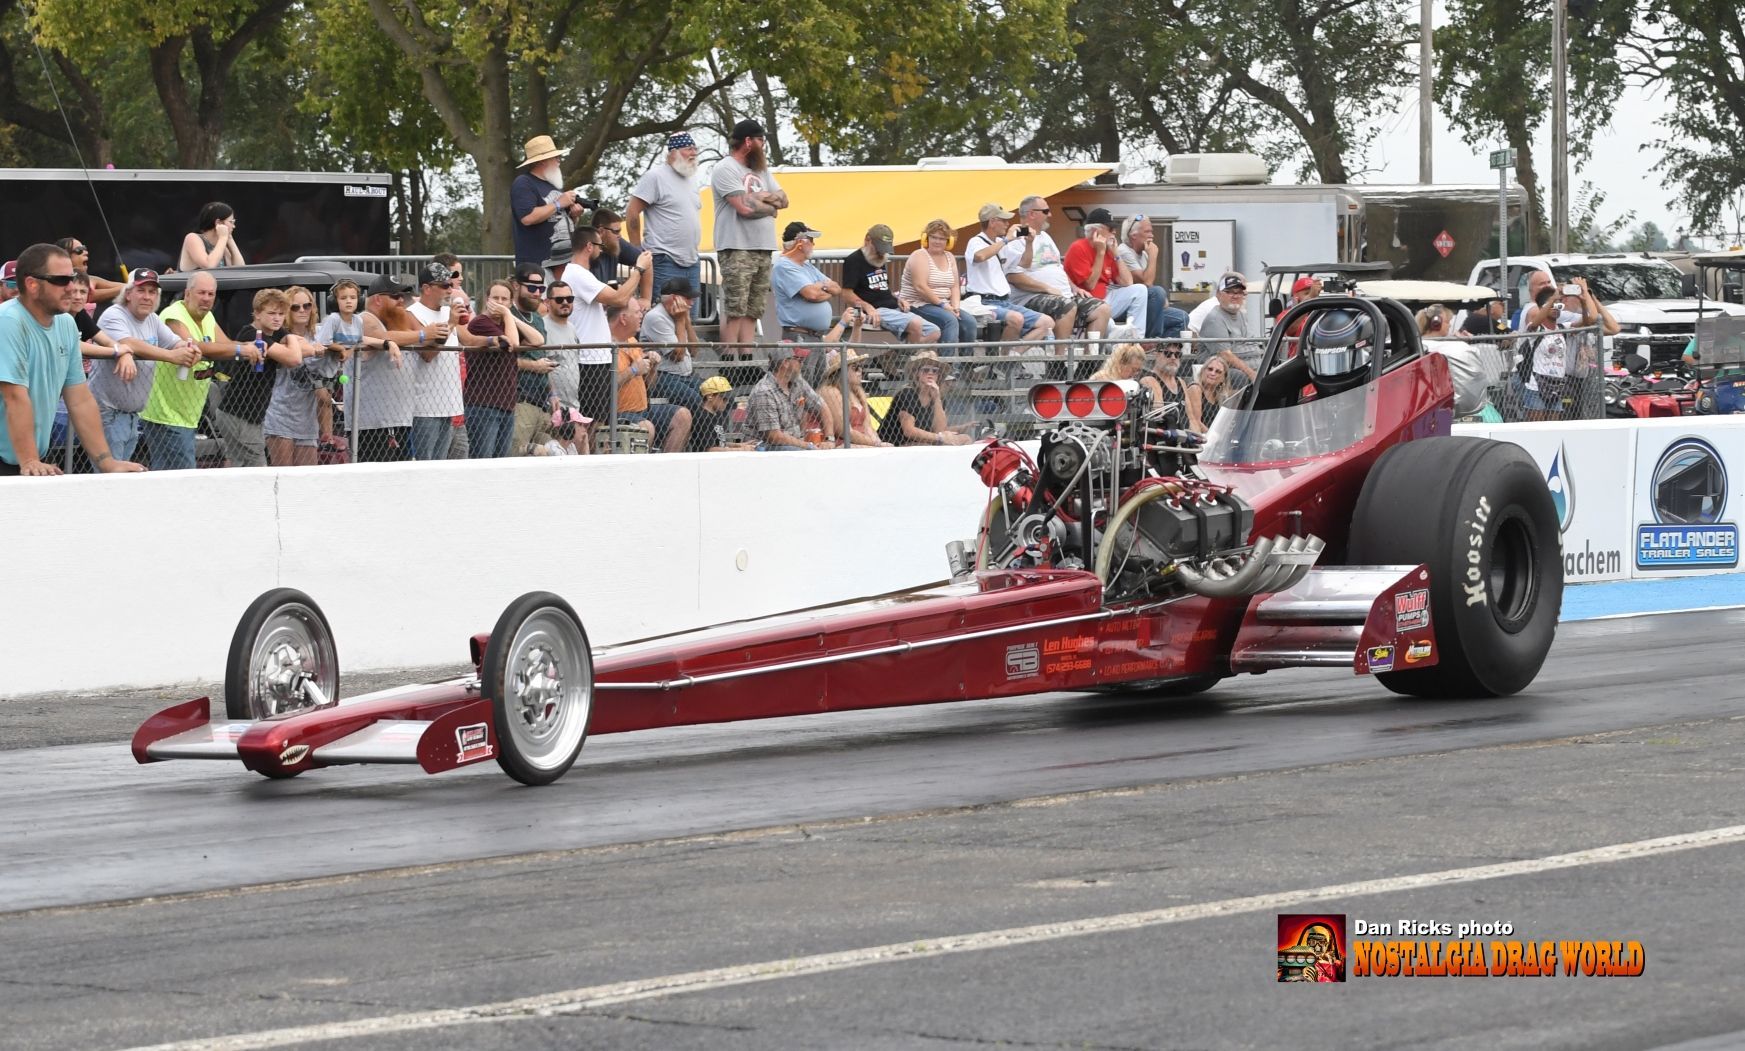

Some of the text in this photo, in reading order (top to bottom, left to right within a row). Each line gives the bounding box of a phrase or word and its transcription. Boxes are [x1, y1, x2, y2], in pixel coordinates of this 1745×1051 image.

[1175, 231, 1200, 240] DRIVEN
[1640, 531, 1735, 548] FLATLANDER
[1462, 496, 1491, 607] Hoosier
[1641, 548, 1735, 558] TRAILER SALES
[1399, 611, 1421, 621] PUMPS
[1044, 639, 1060, 652] Len
[1061, 635, 1095, 650] Hughes
